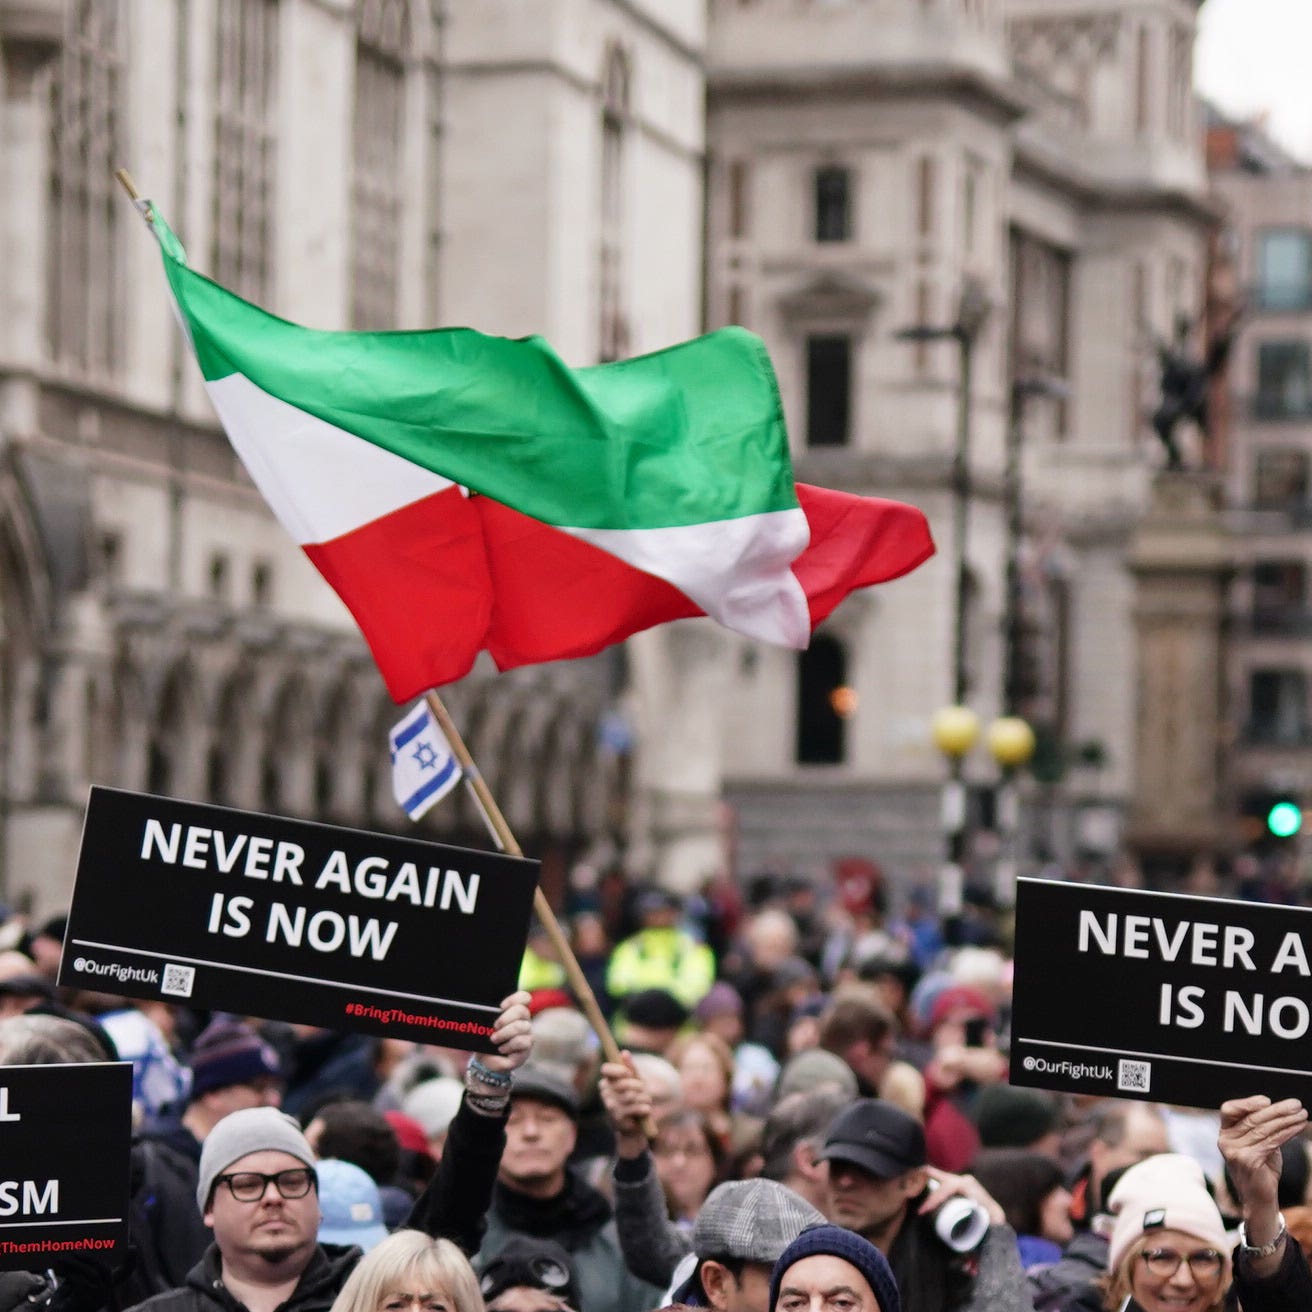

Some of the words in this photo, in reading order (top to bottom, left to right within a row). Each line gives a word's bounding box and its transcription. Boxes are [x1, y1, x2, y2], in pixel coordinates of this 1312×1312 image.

[140, 819, 304, 885] NEVER
[315, 850, 480, 914] AGAIN
[208, 892, 254, 937] IS
[265, 903, 399, 962] NOW
[1078, 910, 1256, 971] NEVER
[72, 956, 159, 984] @OurFightUk
[1159, 983, 1205, 1029] IS
[1022, 1055, 1114, 1081] @OurFightUk
